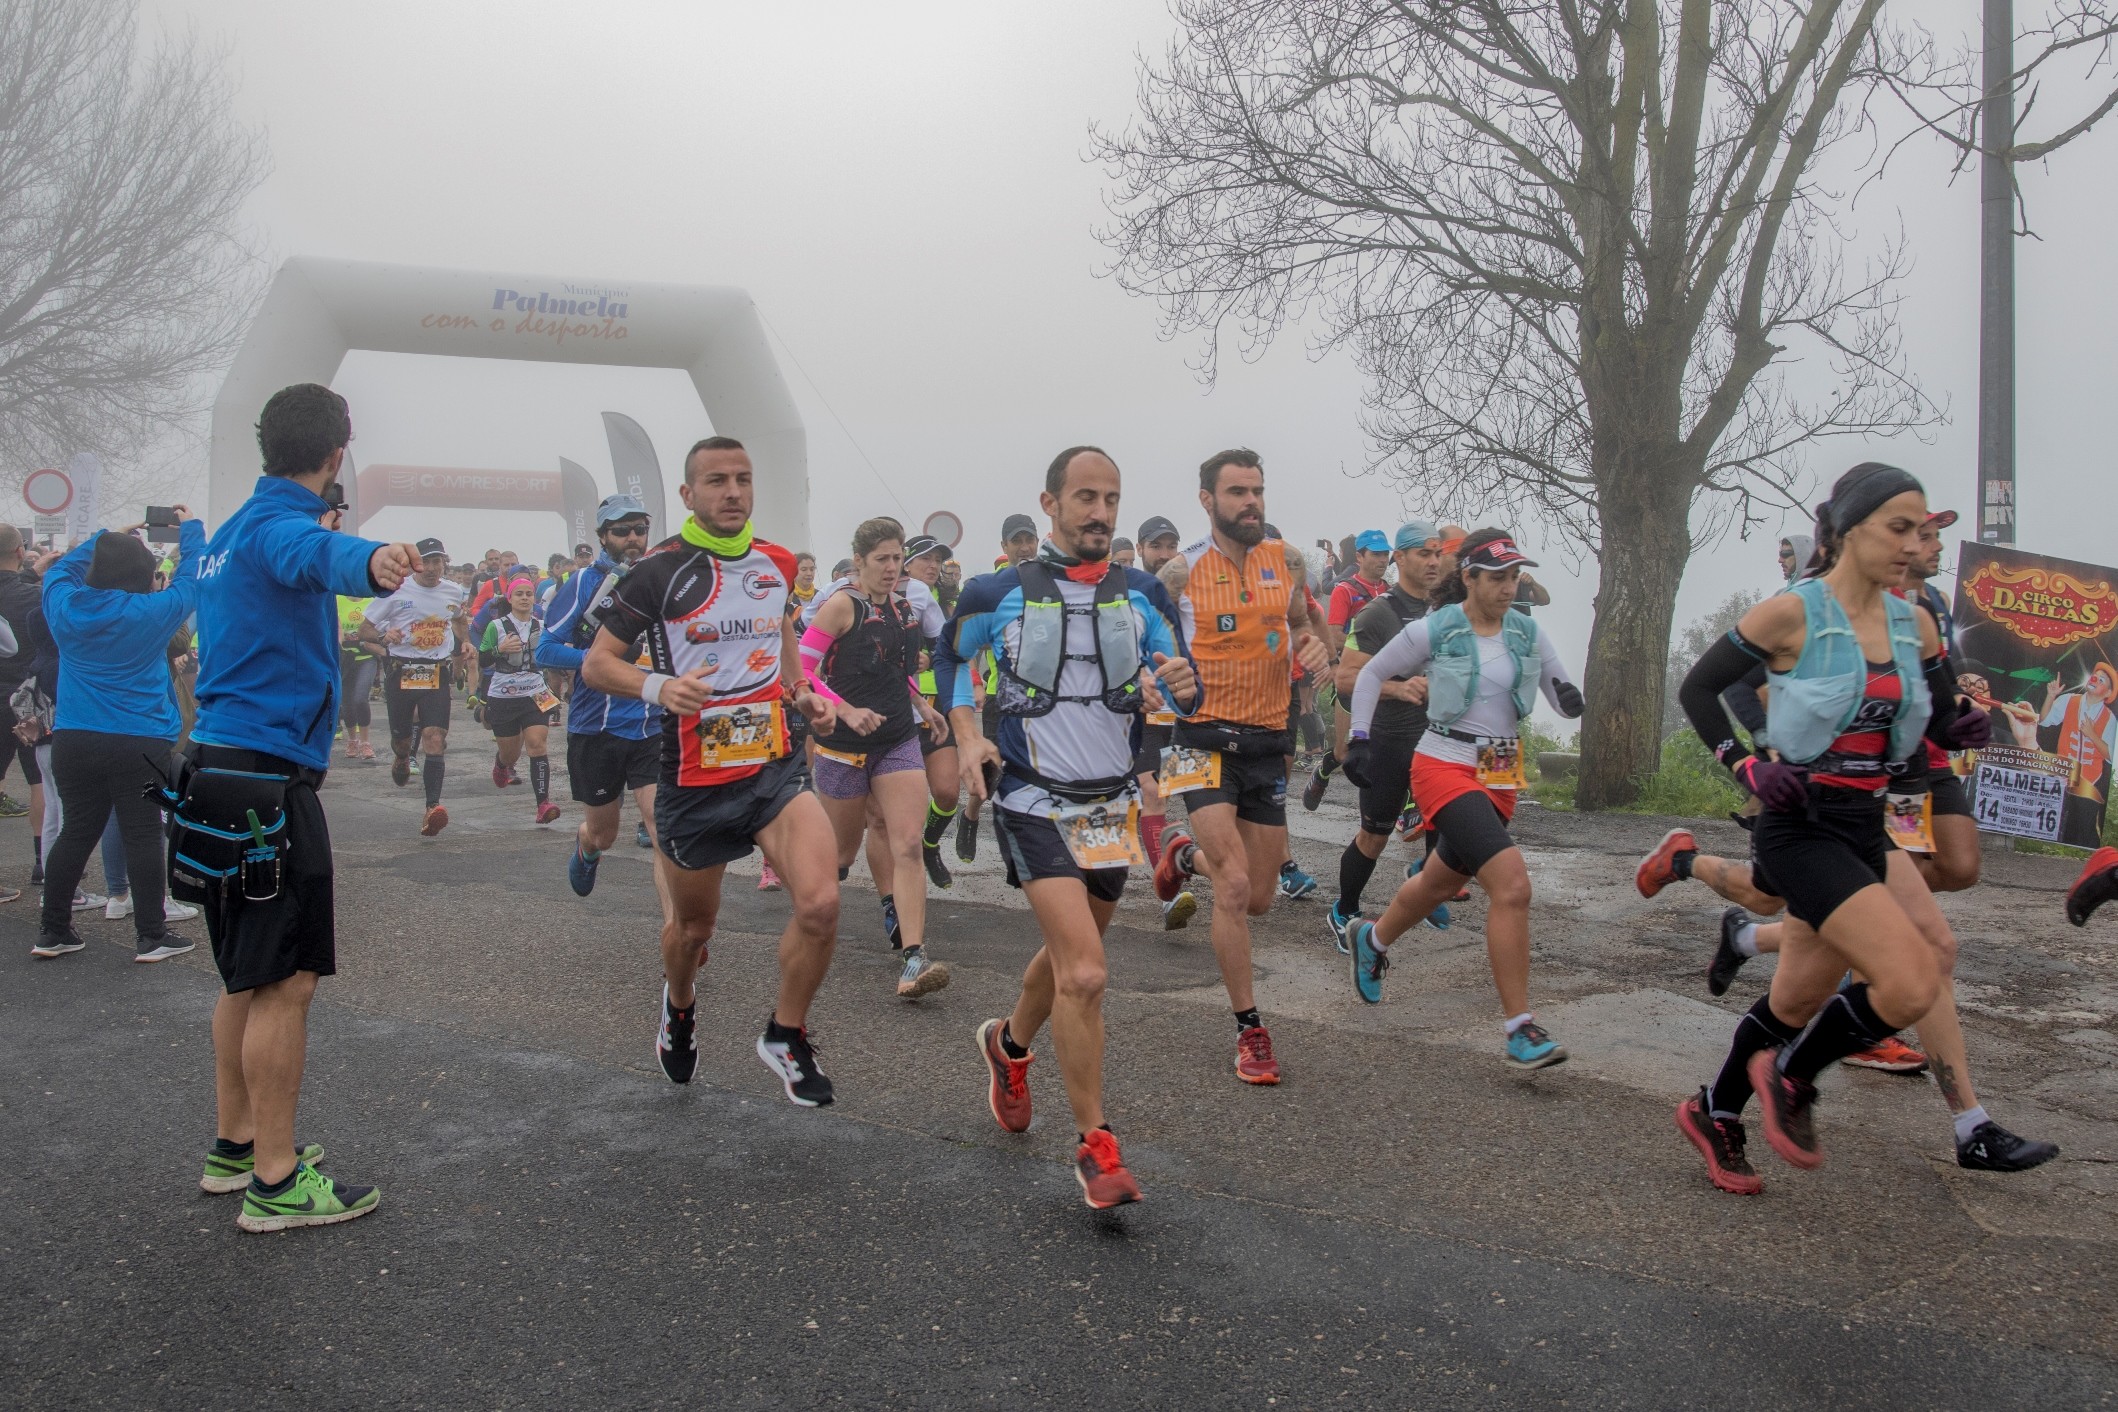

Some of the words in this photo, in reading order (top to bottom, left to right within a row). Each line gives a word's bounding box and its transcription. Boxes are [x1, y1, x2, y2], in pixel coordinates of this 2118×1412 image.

[564, 283, 629, 299] Município
[490, 288, 629, 319] Palmela
[420, 312, 478, 329] com
[488, 317, 505, 332] o
[514, 307, 629, 344] desporto
[1991, 586, 2100, 626] DALLAS
[2021, 590, 2075, 609] CIRCO
[721, 633, 749, 642] GESTÃO
[730, 726, 757, 746] 47
[1176, 758, 1197, 775] 42
[1975, 753, 1999, 762] ALÉM
[1987, 746, 2050, 762] ESPECTÁCULO
[2052, 757, 2075, 769] PARA
[1980, 766, 2062, 797] PALMELA
[1978, 797, 2000, 822] 14
[2036, 807, 2057, 833] 16
[1082, 826, 1120, 849] 384
